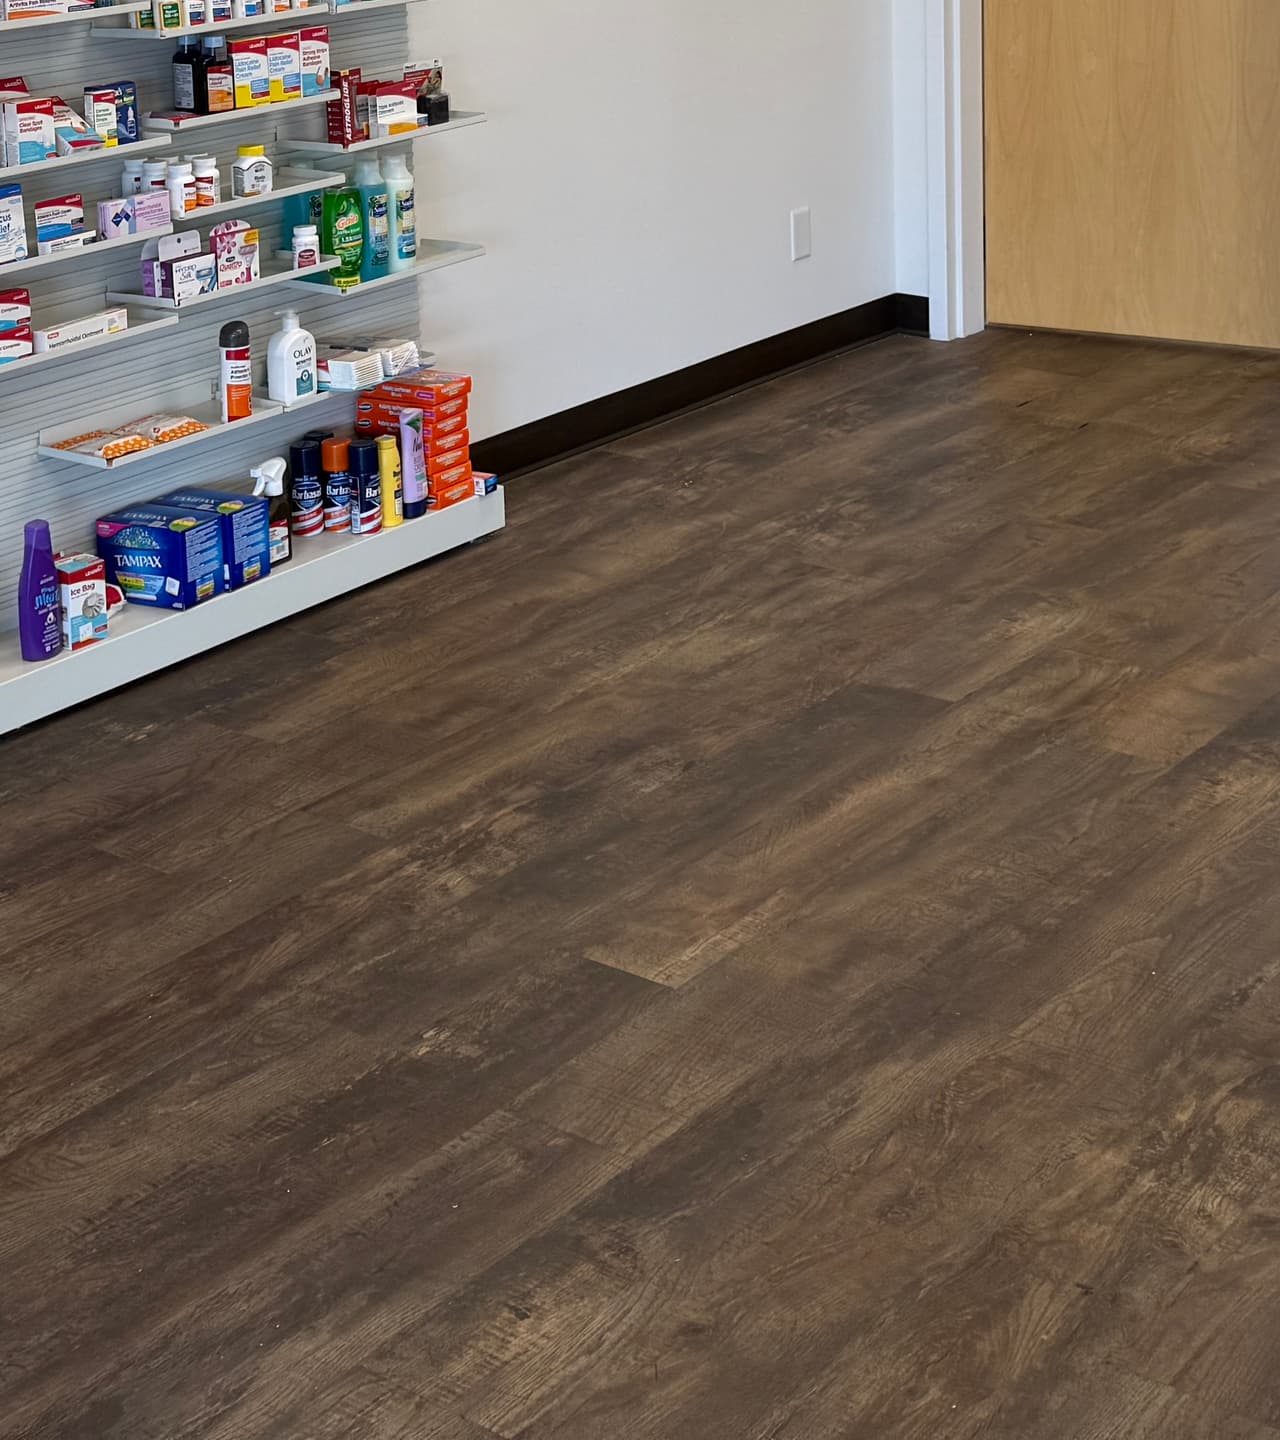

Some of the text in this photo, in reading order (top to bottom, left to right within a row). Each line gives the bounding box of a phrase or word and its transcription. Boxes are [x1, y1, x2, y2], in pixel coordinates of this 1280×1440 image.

[343, 80, 352, 140] ASTROGLIDE
[293, 347, 313, 359] OLAY
[114, 554, 162, 569] TAMPAX
[70, 583, 95, 597] Ice Bag
